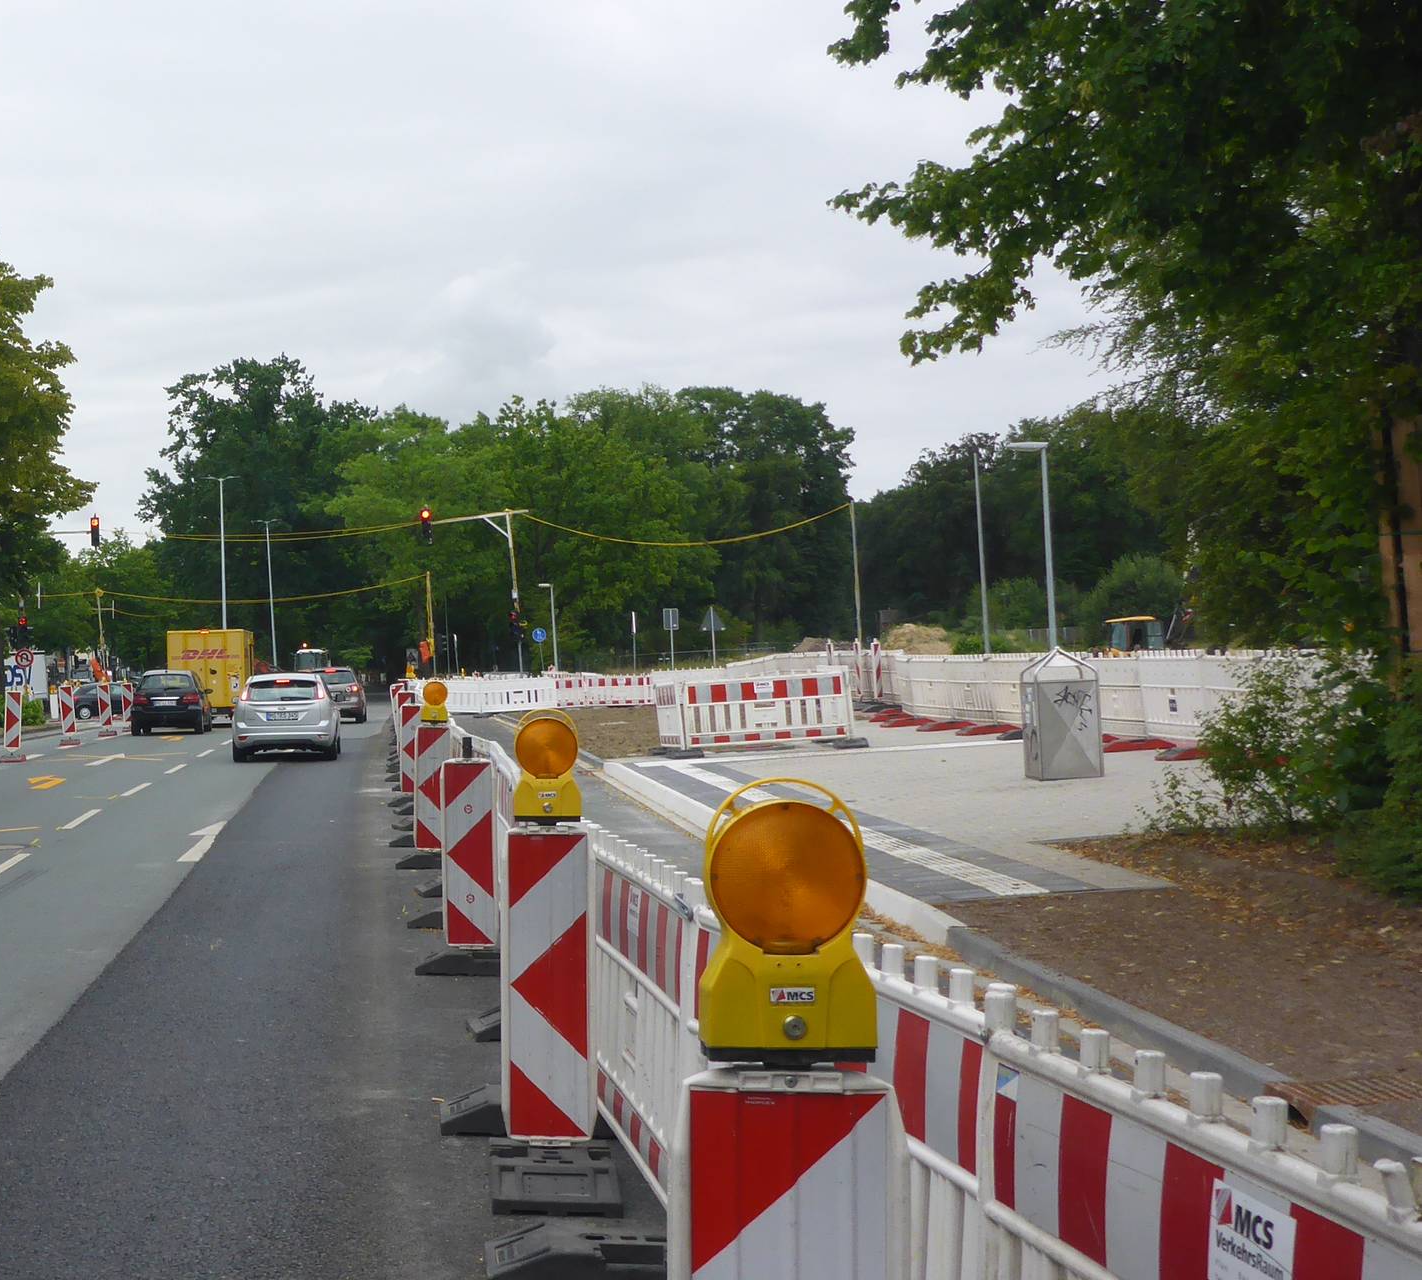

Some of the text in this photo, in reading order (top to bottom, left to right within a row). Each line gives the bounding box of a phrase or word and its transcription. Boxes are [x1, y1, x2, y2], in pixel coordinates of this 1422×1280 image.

[181, 649, 230, 660] DHL
[786, 990, 814, 1001] MCS
[1234, 1204, 1275, 1250] MCS
[1215, 1229, 1284, 1280] VerkehrsRaum
